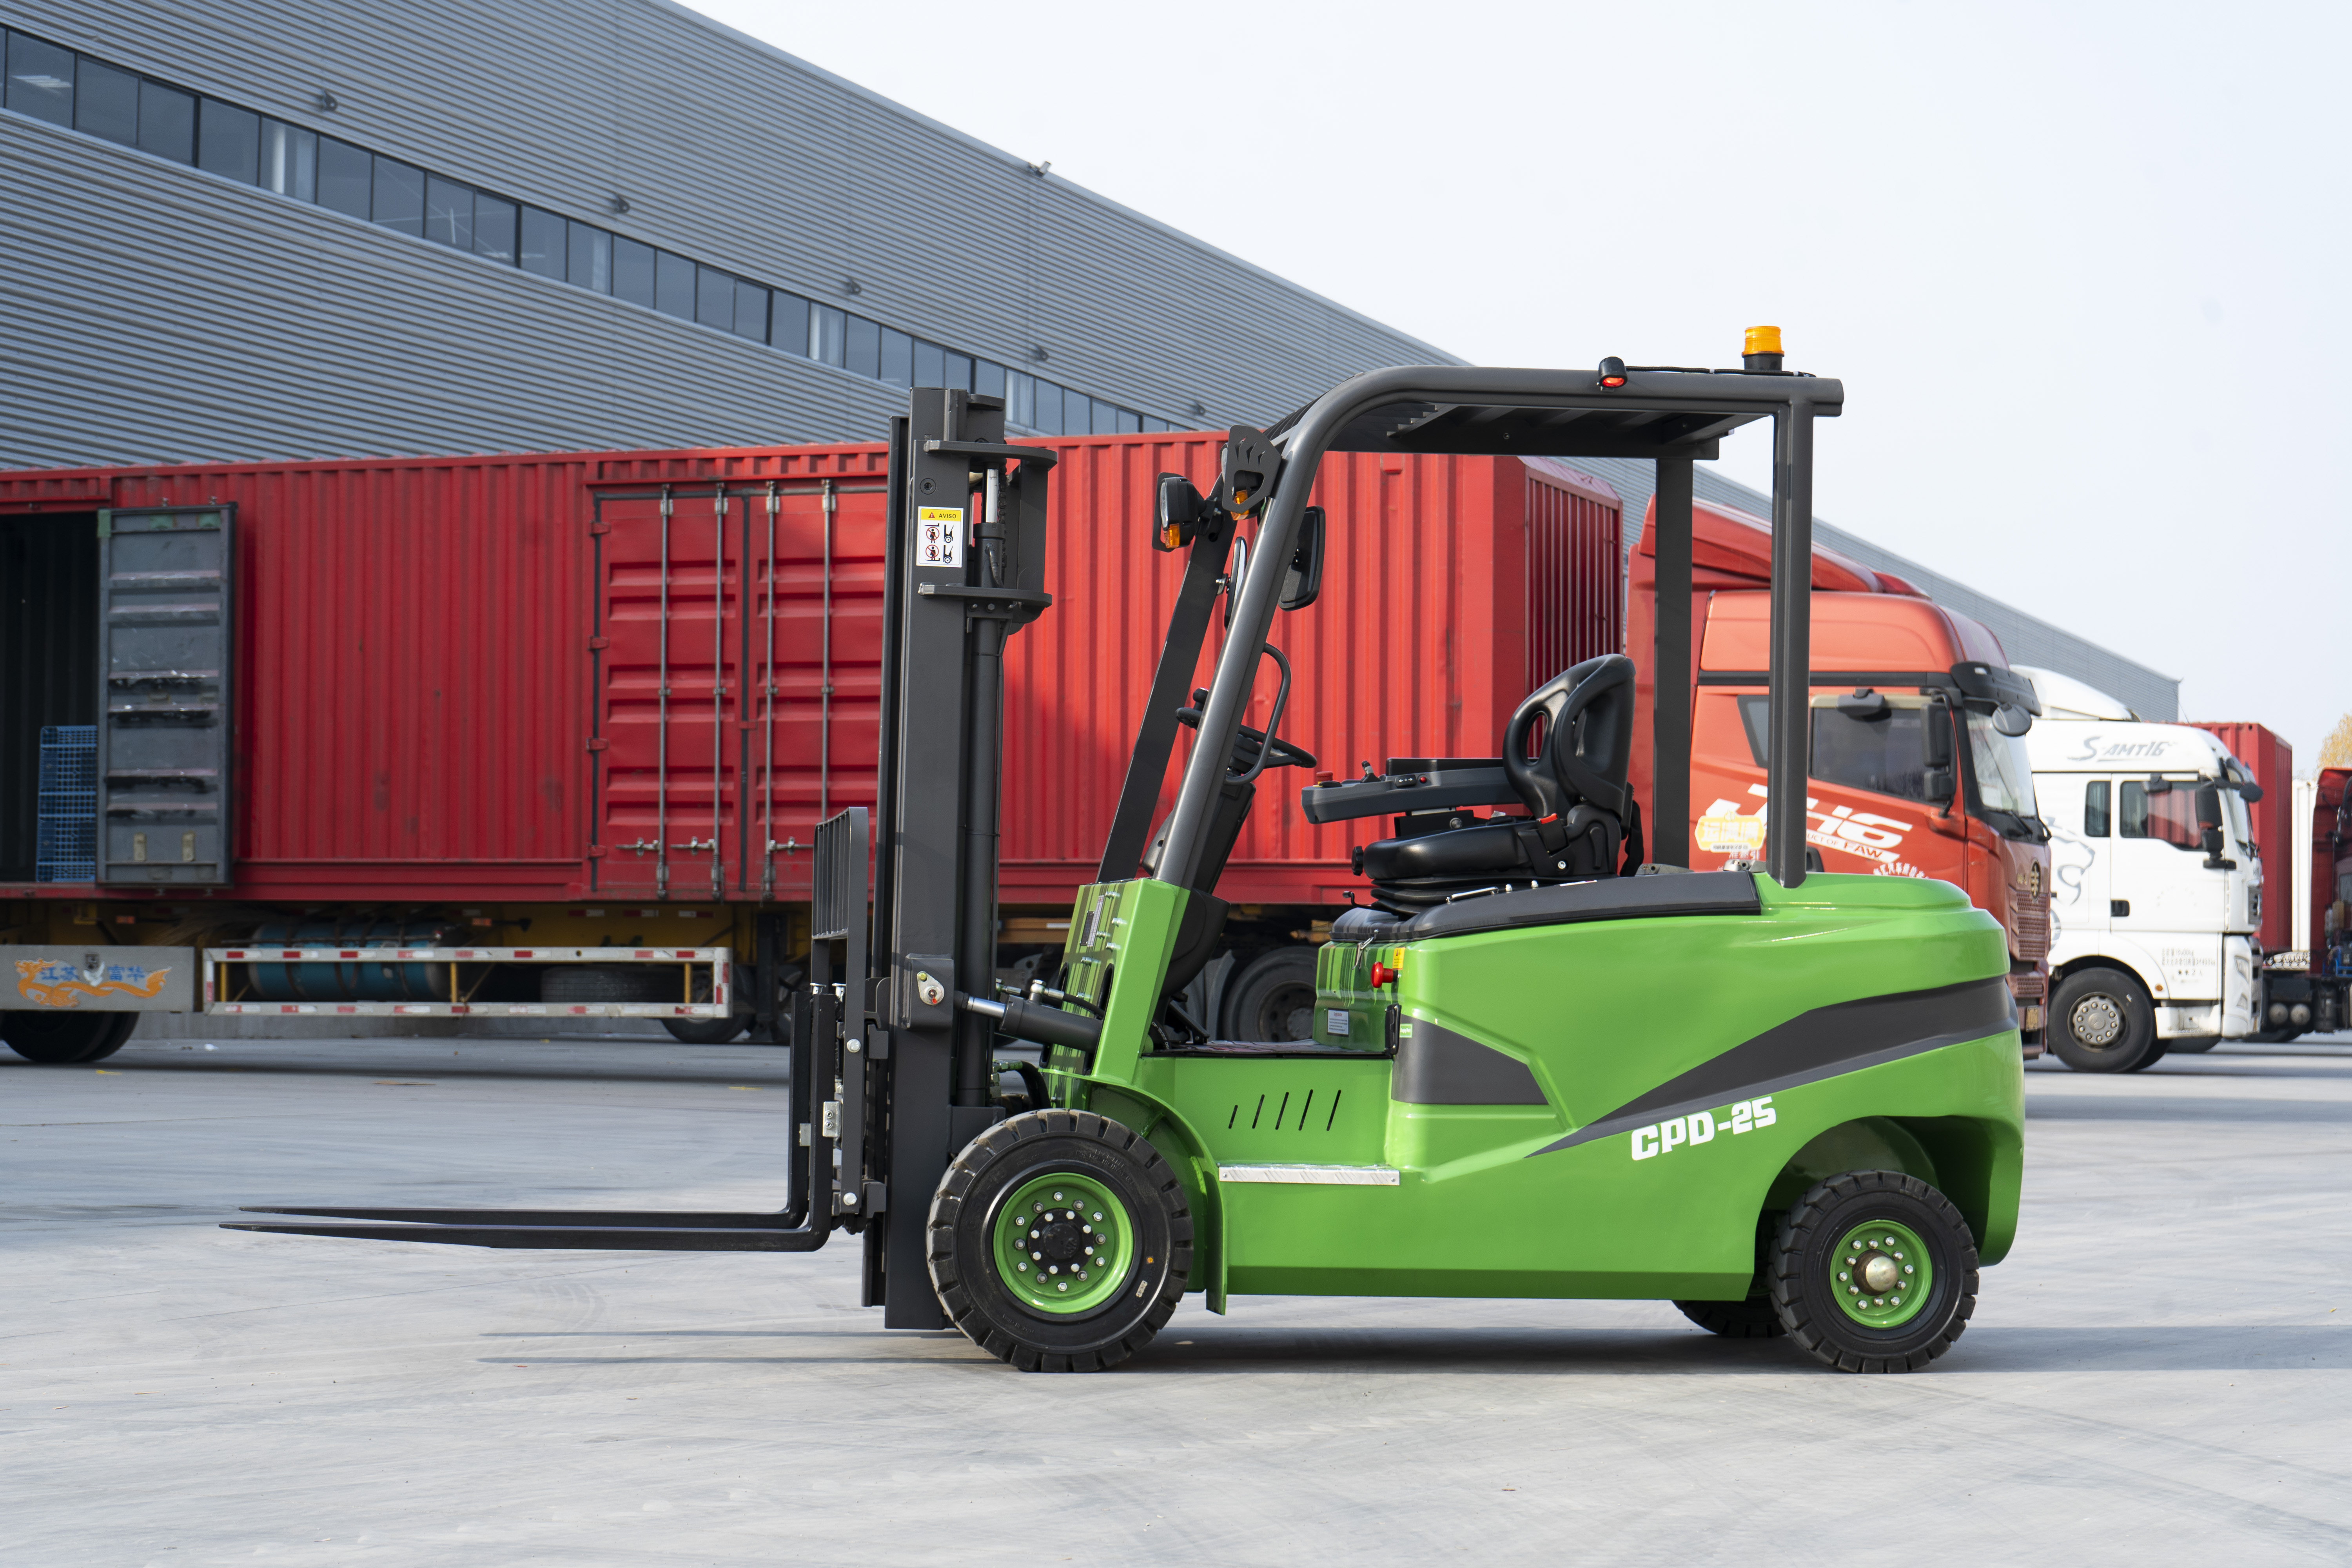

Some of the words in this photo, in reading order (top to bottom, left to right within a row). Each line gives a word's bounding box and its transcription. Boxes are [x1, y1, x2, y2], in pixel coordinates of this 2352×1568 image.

[1844, 842, 1883, 858] FAW
[40, 966, 78, 980] 江苏
[107, 965, 145, 981] 富华
[1631, 1096, 1776, 1161] CPD-25
